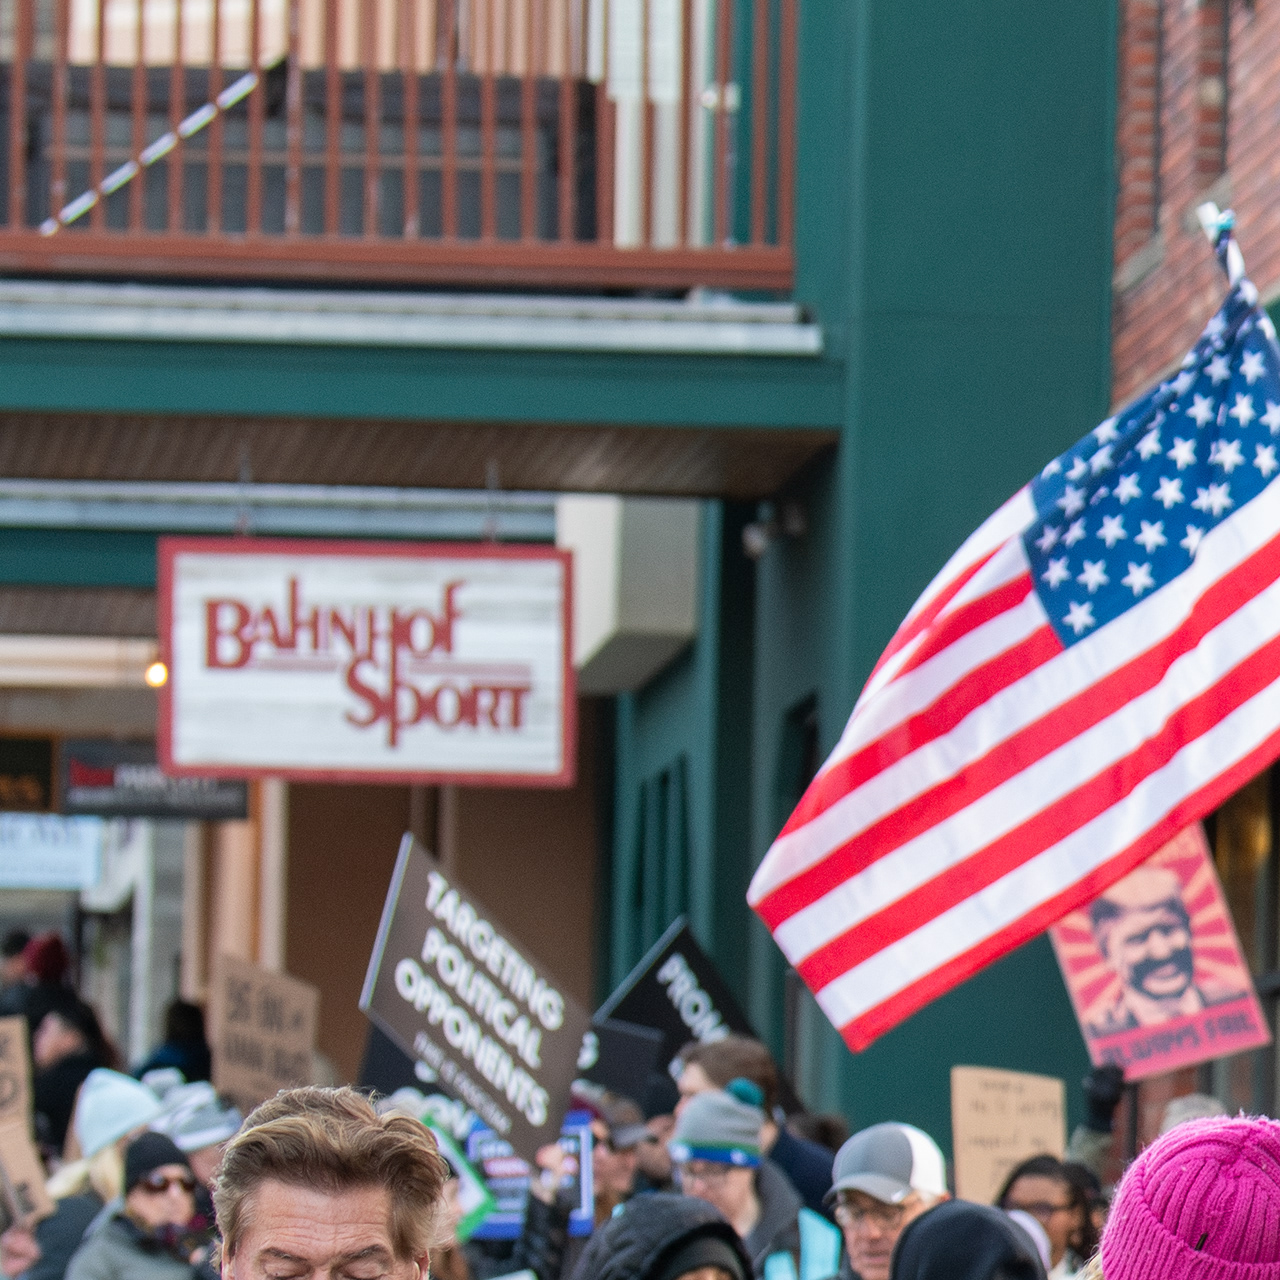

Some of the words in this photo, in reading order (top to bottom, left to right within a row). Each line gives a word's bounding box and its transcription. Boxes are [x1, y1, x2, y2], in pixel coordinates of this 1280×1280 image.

[421, 926, 543, 1070] POLITICAL
[425, 870, 565, 1031] TARGETING
[394, 957, 549, 1127] OPPONENTS
